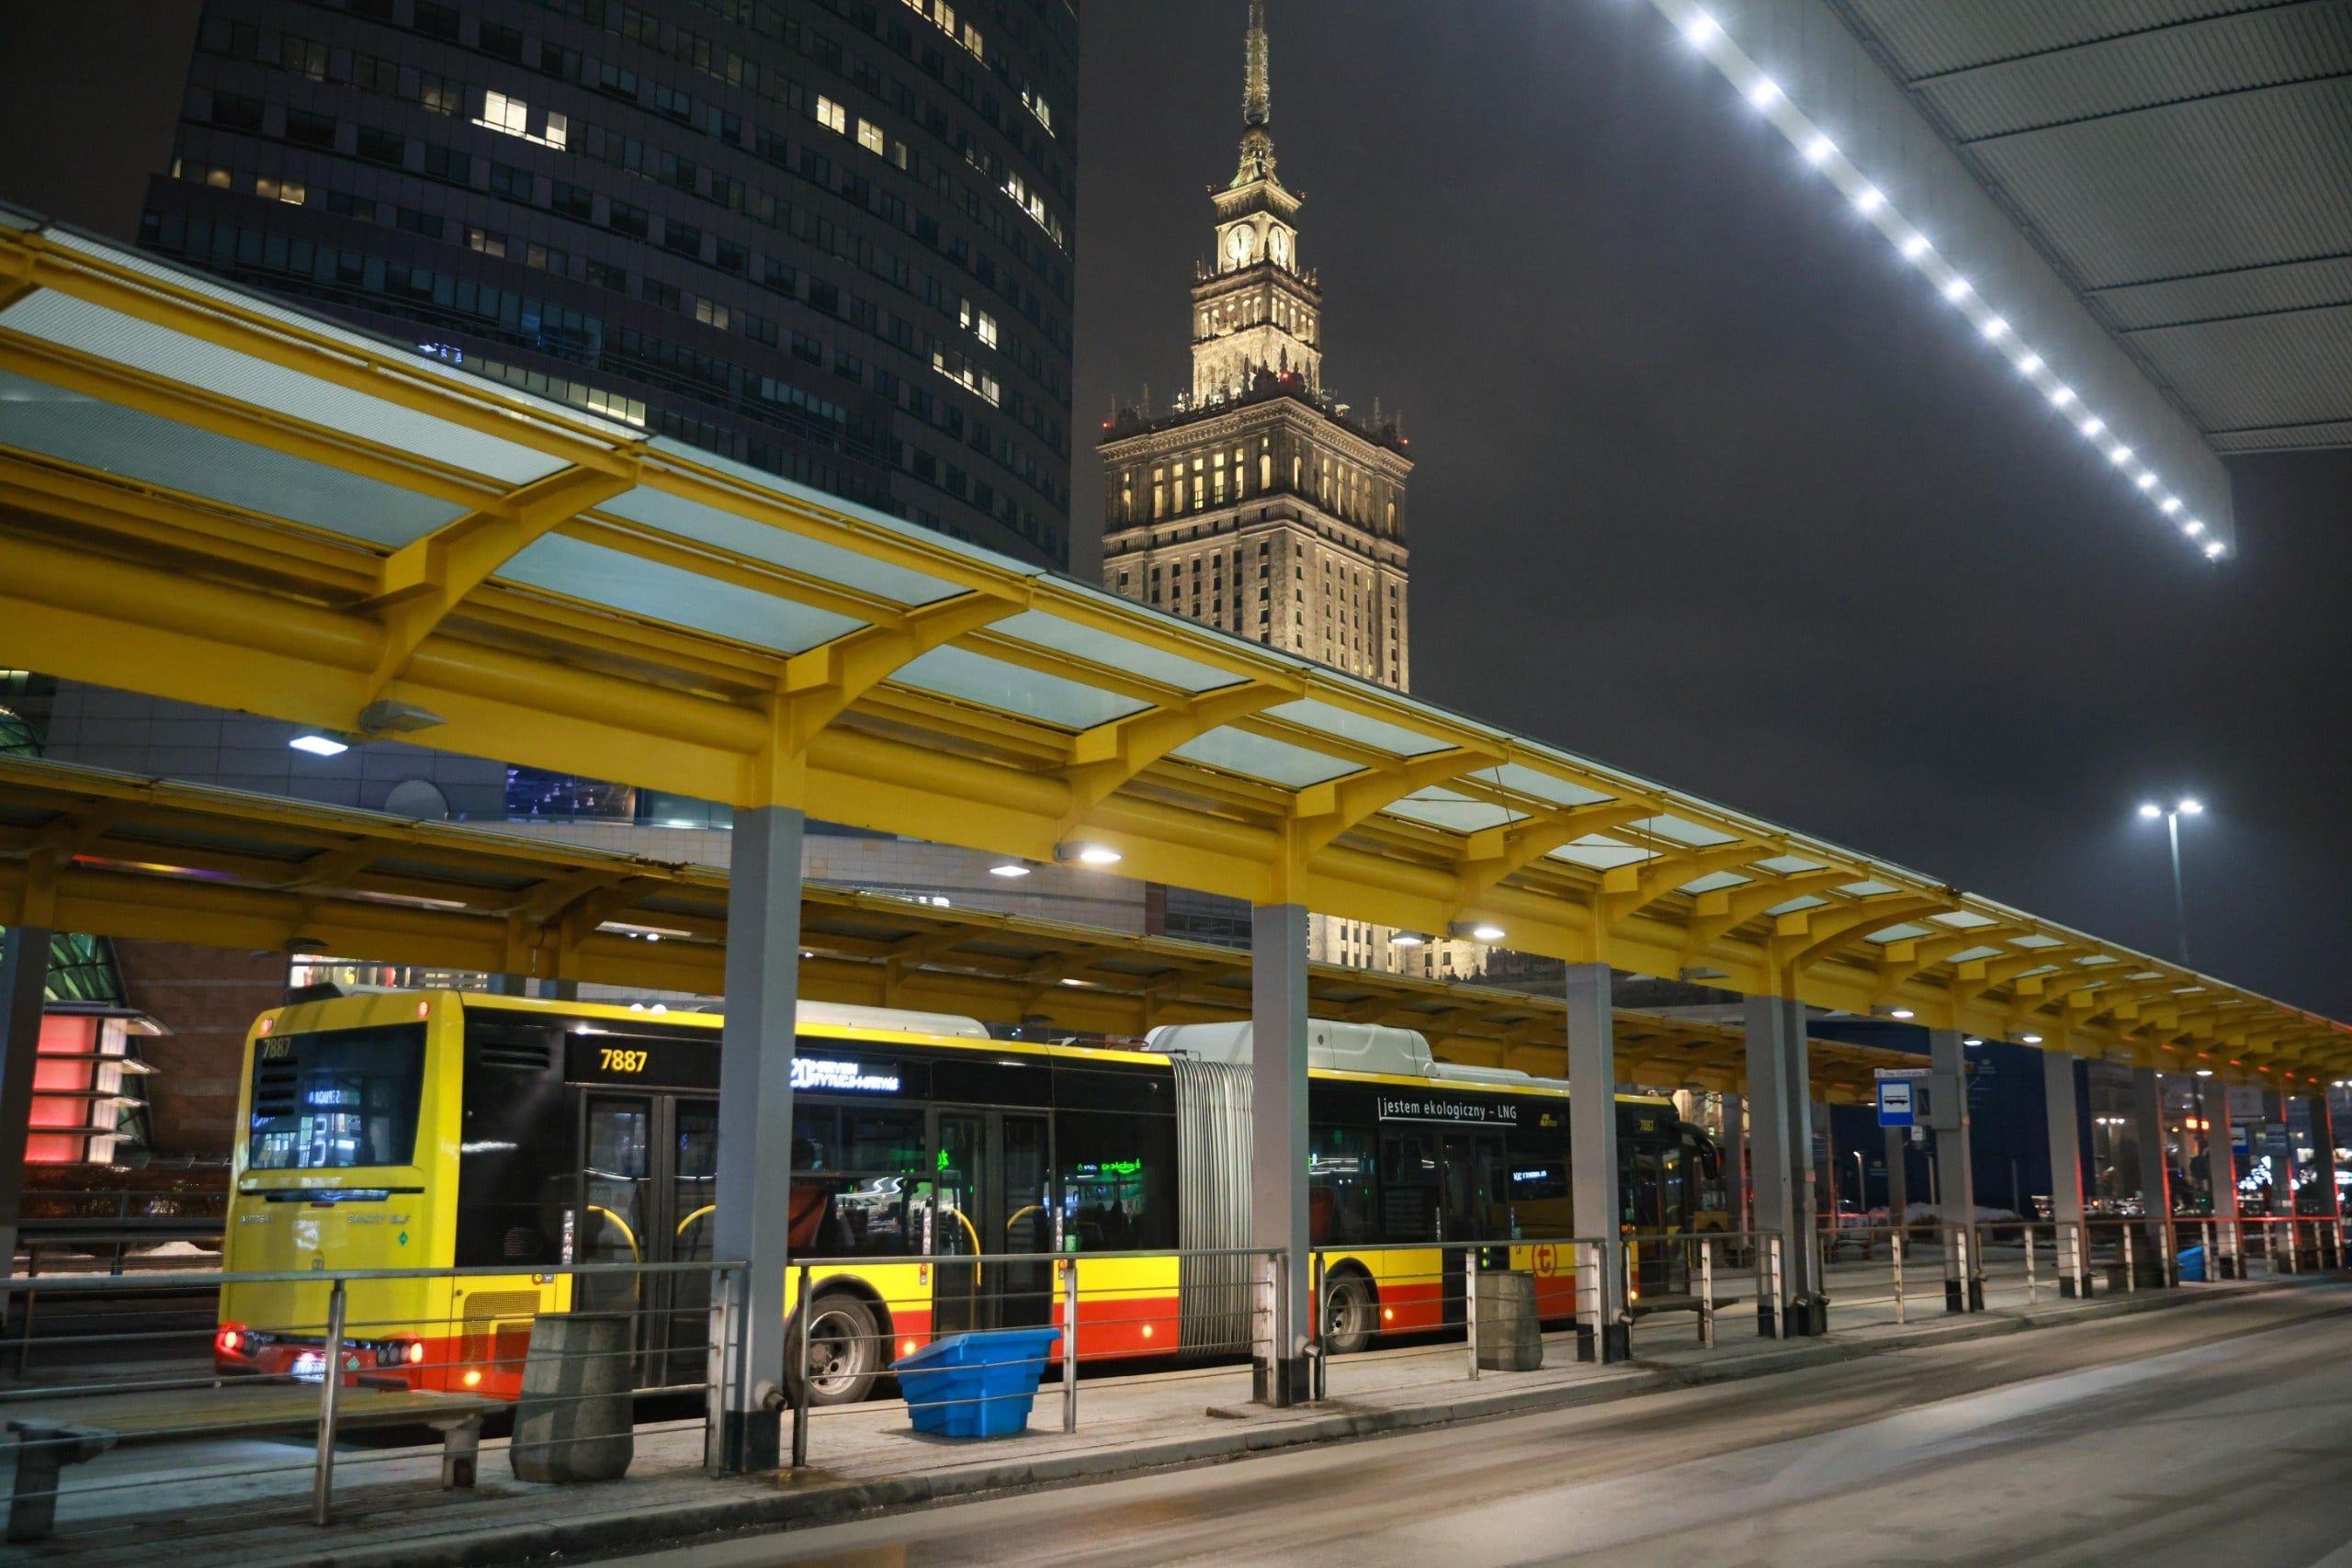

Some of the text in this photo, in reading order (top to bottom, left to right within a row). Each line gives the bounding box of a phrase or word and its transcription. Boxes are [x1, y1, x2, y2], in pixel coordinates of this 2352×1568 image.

[263, 1039, 291, 1058] 7887
[600, 1048, 648, 1073] 7887
[1384, 1098, 1420, 1116] jestem
[1424, 1100, 1486, 1121] ekologiczny
[1498, 1105, 1517, 1119] LNG
